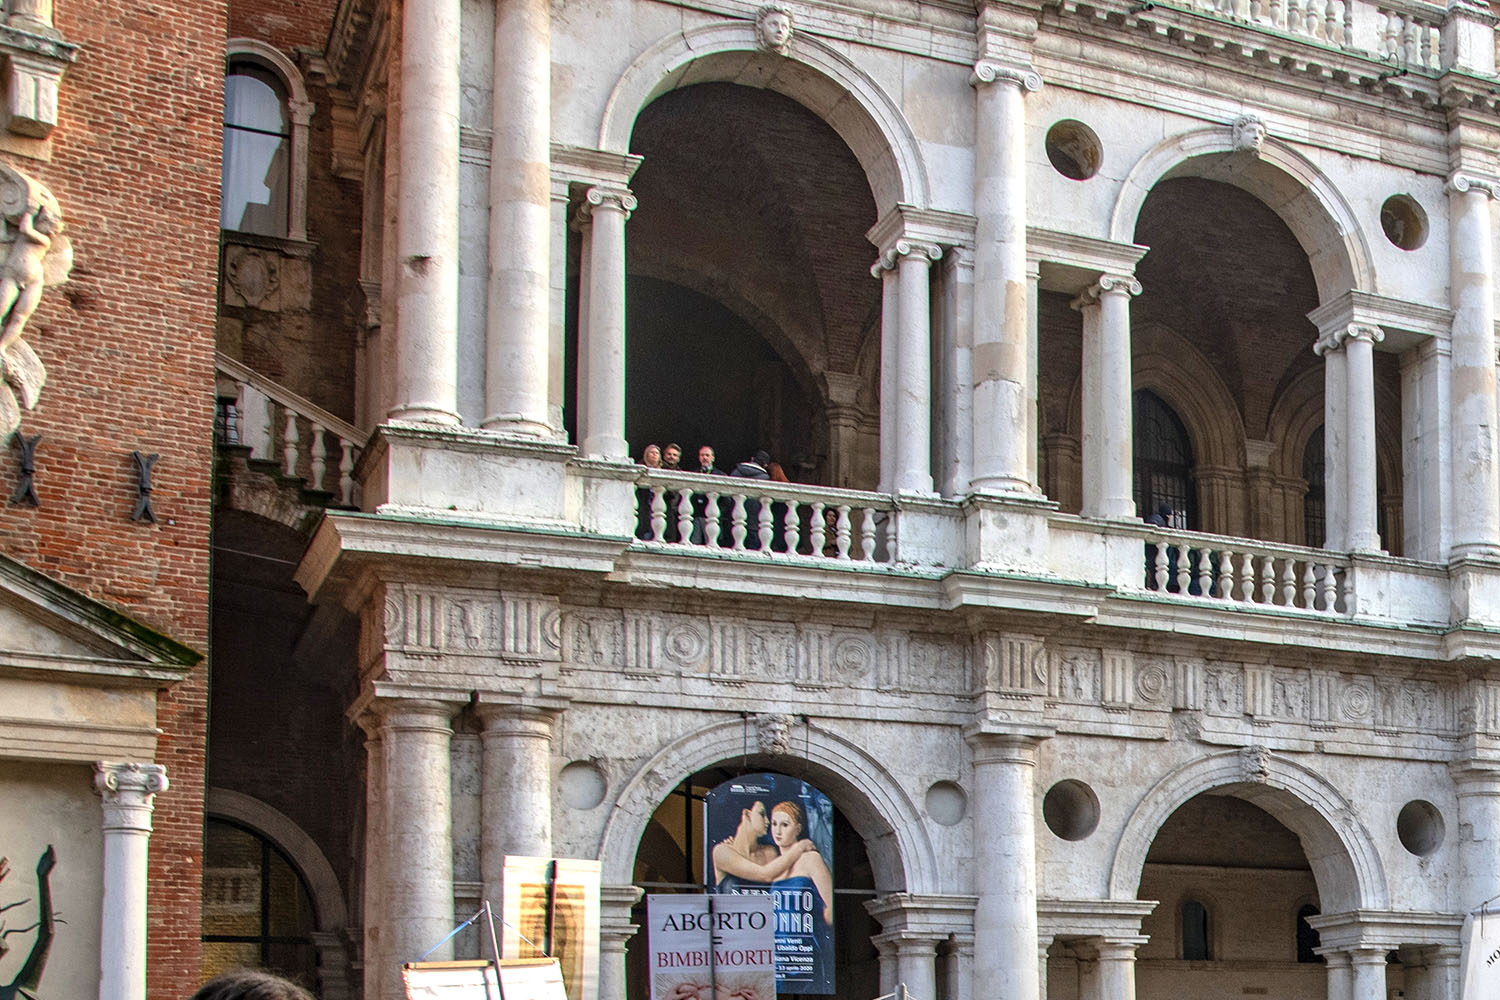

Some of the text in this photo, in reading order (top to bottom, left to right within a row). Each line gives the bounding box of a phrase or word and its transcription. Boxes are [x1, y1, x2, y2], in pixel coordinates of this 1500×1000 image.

[662, 911, 766, 932] ABORTO
[774, 913, 814, 933] NNA
[657, 950, 773, 968] BIMBI MORTI
